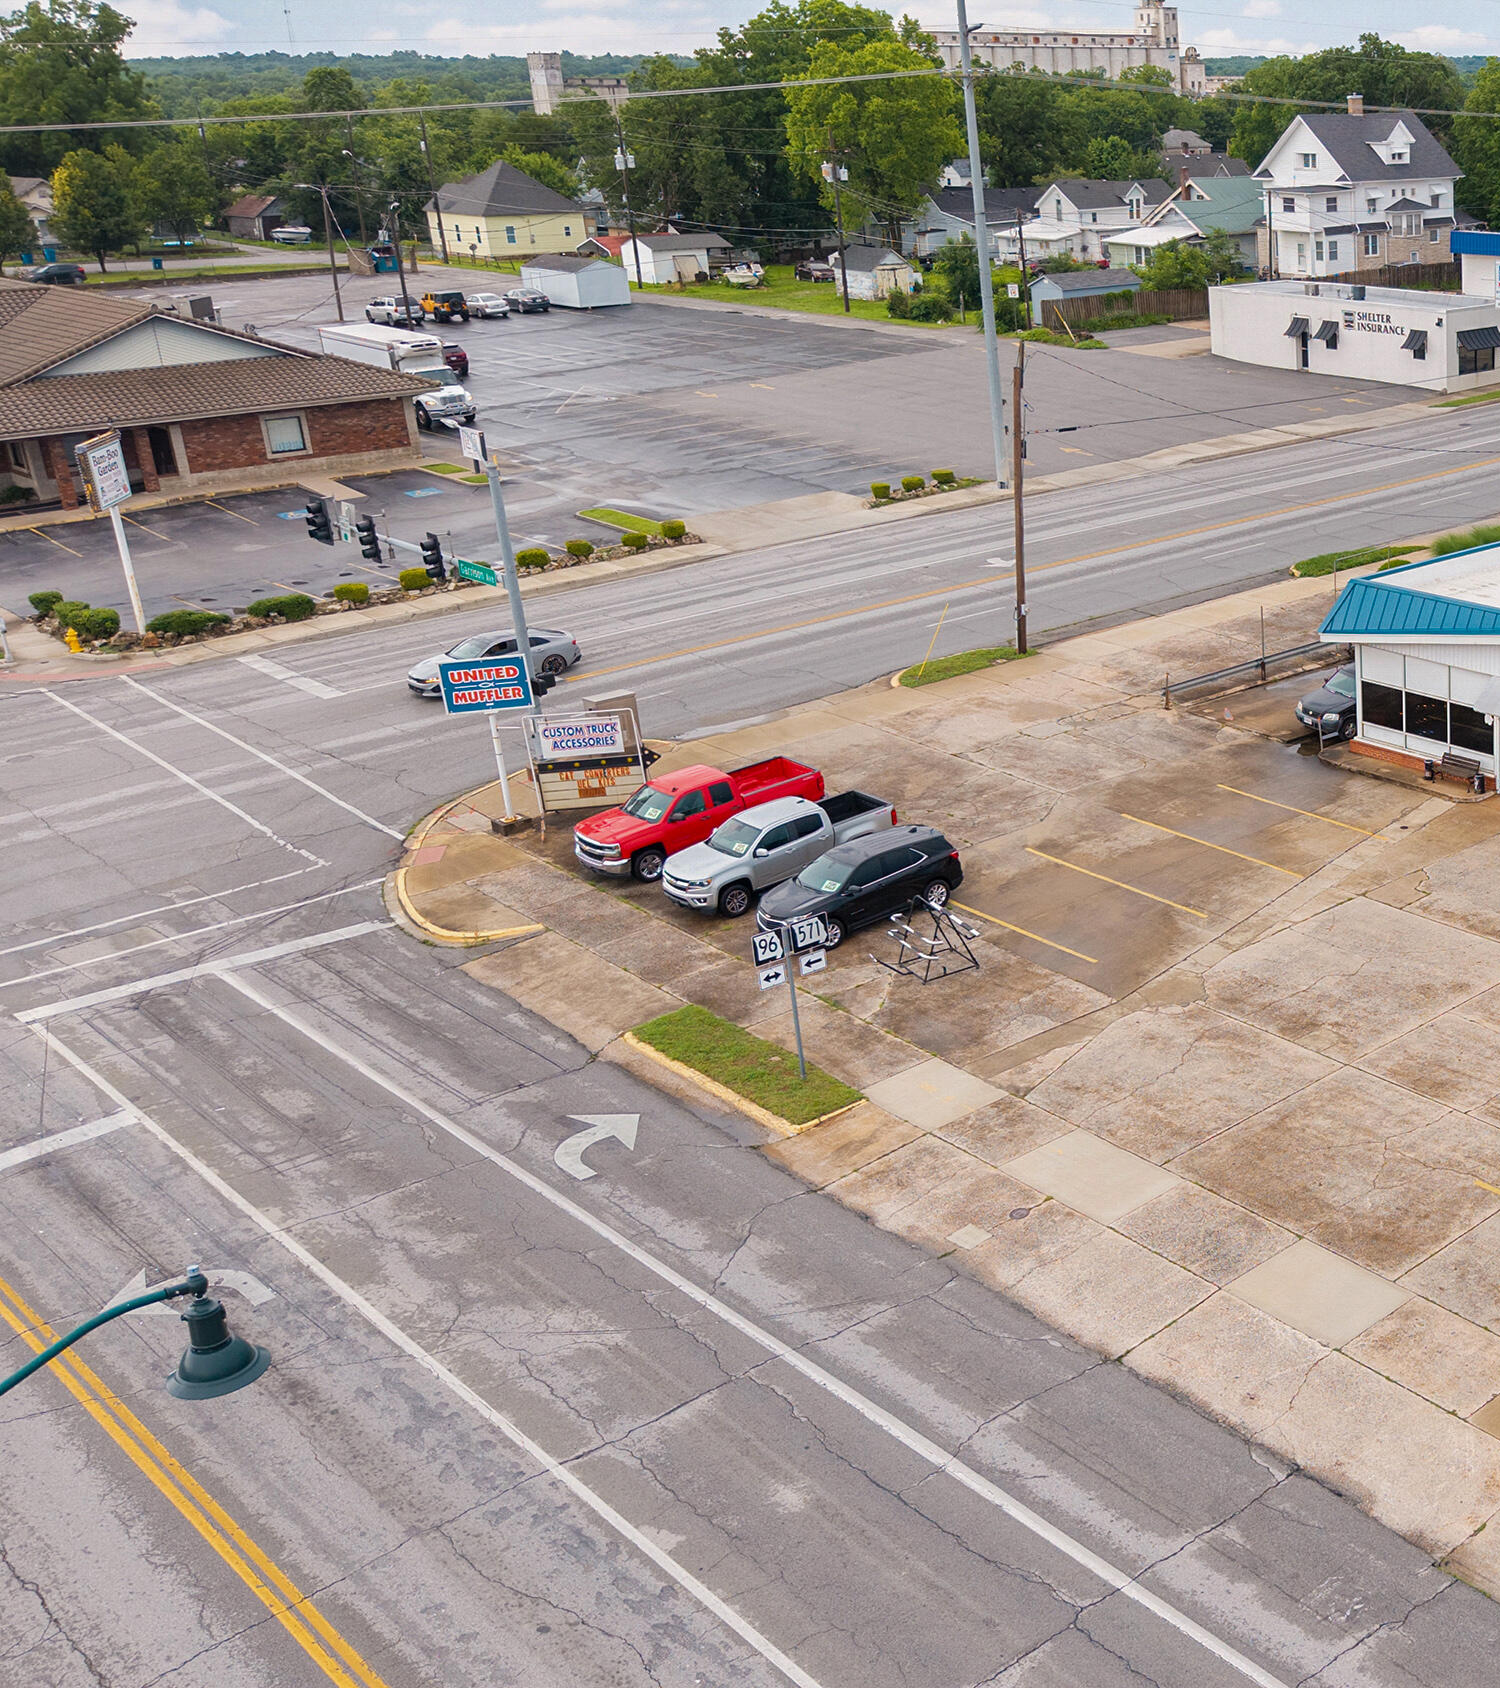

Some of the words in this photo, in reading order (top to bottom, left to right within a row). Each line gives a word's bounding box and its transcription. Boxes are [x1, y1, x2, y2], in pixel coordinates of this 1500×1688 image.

[1357, 312, 1391, 323] SHELTER
[1357, 322, 1406, 335] INSURANCE
[92, 449, 118, 467] Bam-Boo
[97, 461, 119, 476] Garden
[460, 563, 485, 581] Garrison
[449, 666, 519, 684] UNITED
[453, 687, 524, 705] MUFFLER
[543, 726, 584, 738] CUSTOM
[586, 722, 617, 734] TRUCK
[552, 736, 615, 750] ACCESSORIES
[559, 771, 574, 781] CAT
[798, 921, 821, 943] 571
[758, 936, 778, 955] 96
